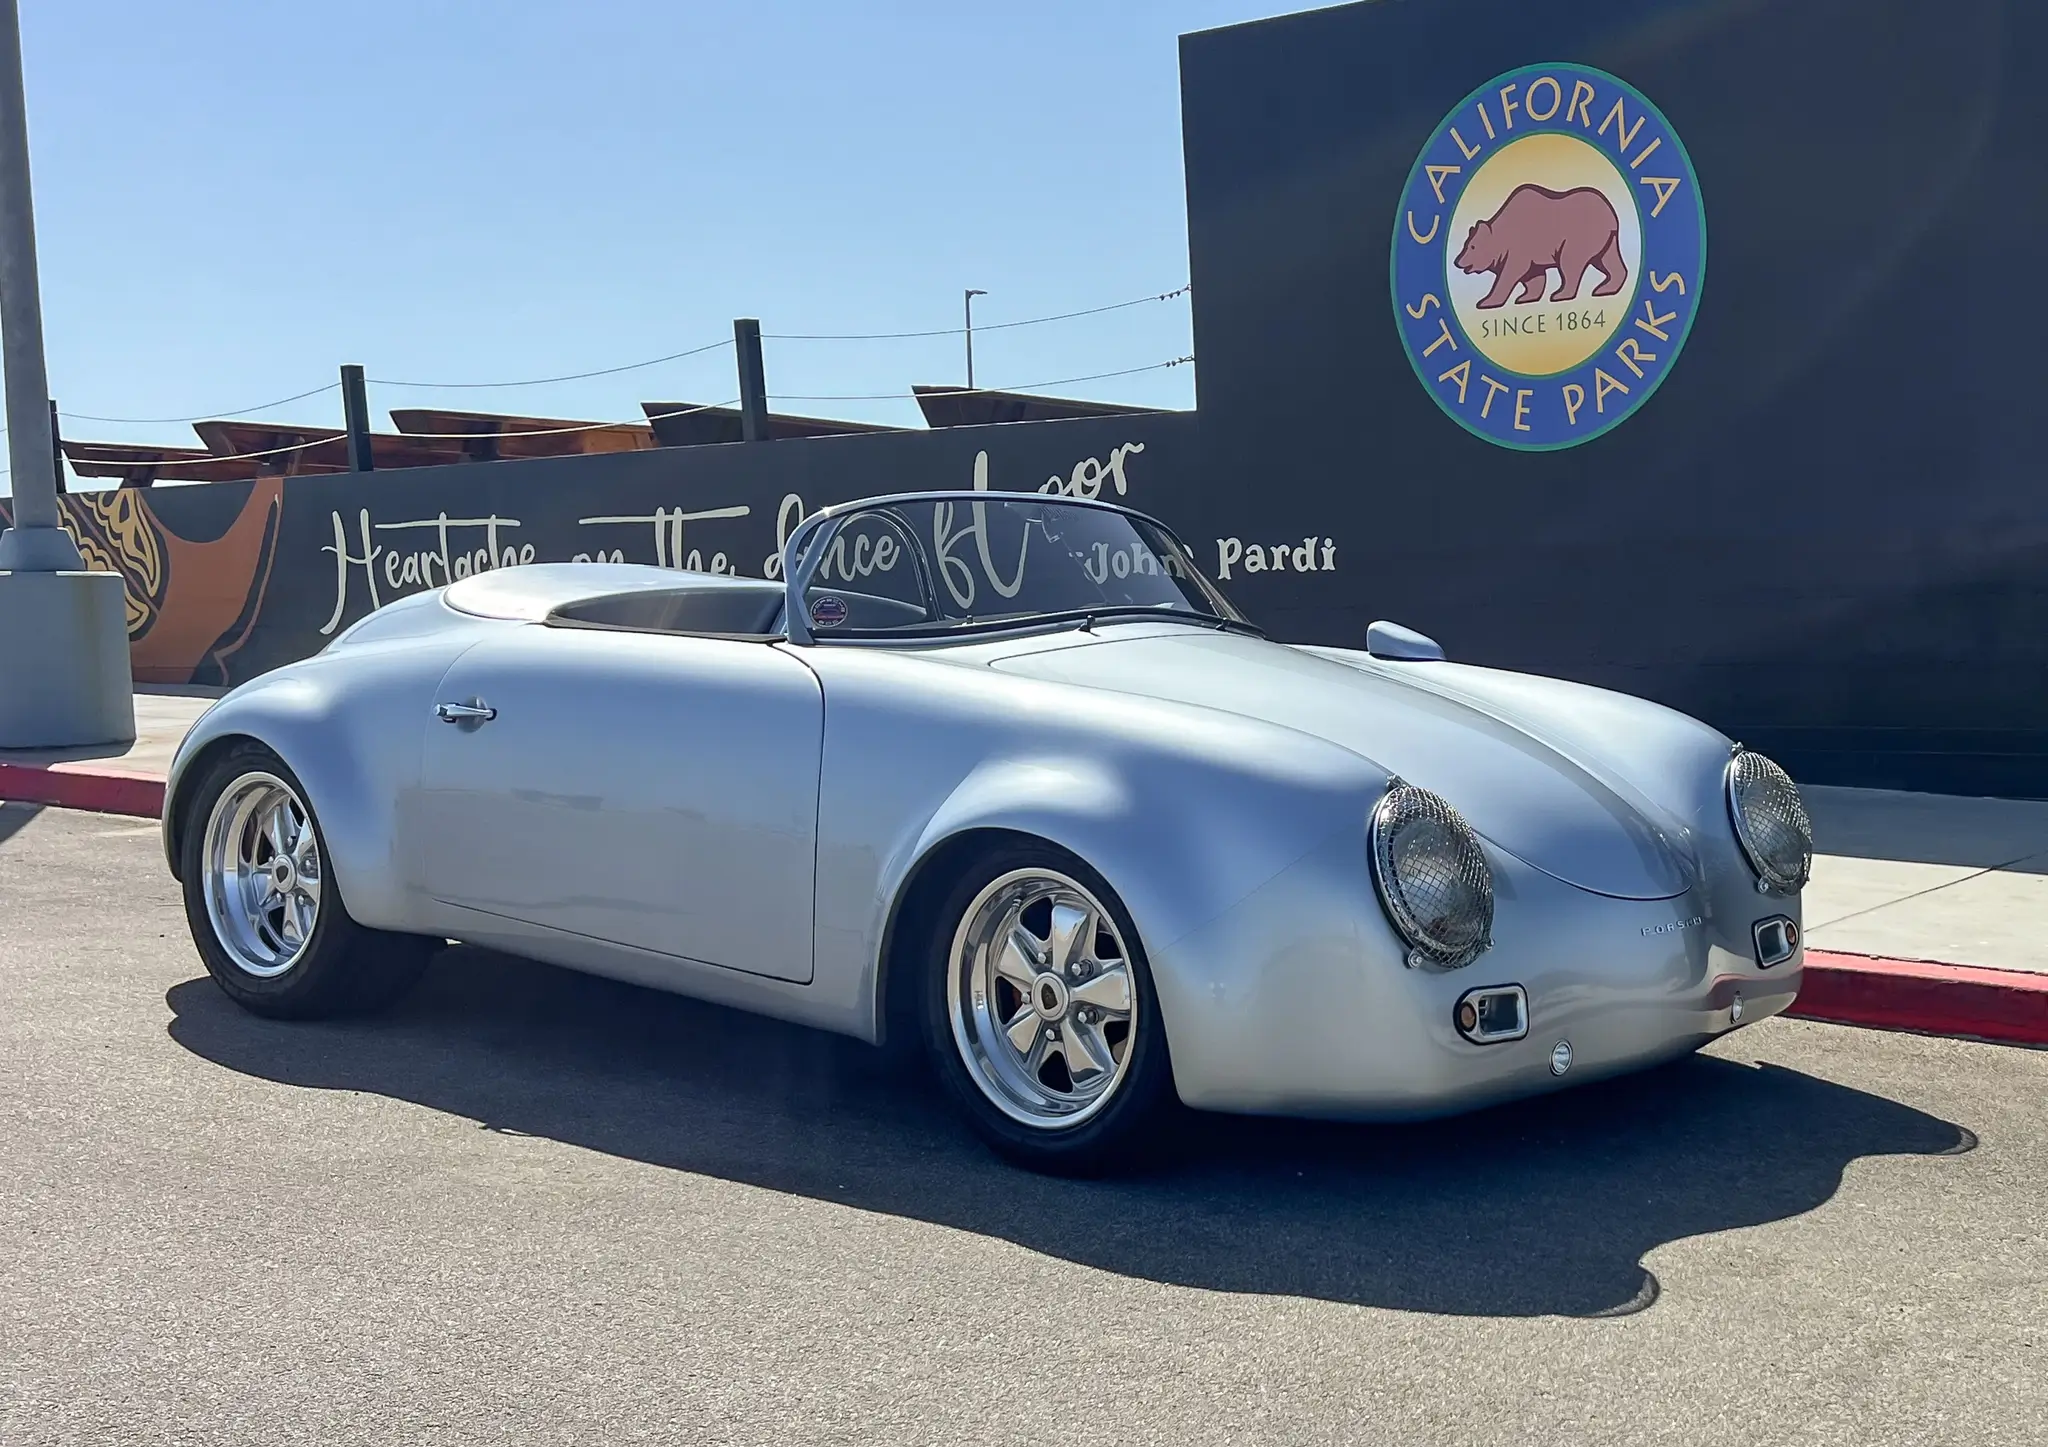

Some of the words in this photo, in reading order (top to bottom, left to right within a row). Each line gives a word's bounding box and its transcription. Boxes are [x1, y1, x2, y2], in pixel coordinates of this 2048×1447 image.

[1407, 76, 1681, 244] CALIFORNIA
[1405, 293, 1534, 431] STATE
[1562, 270, 1686, 425] PARKS
[1482, 314, 1546, 338] SINCE
[1556, 309, 1606, 331] 1864
[763, 493, 900, 582] dnce
[1216, 536, 1337, 580] Pardi
